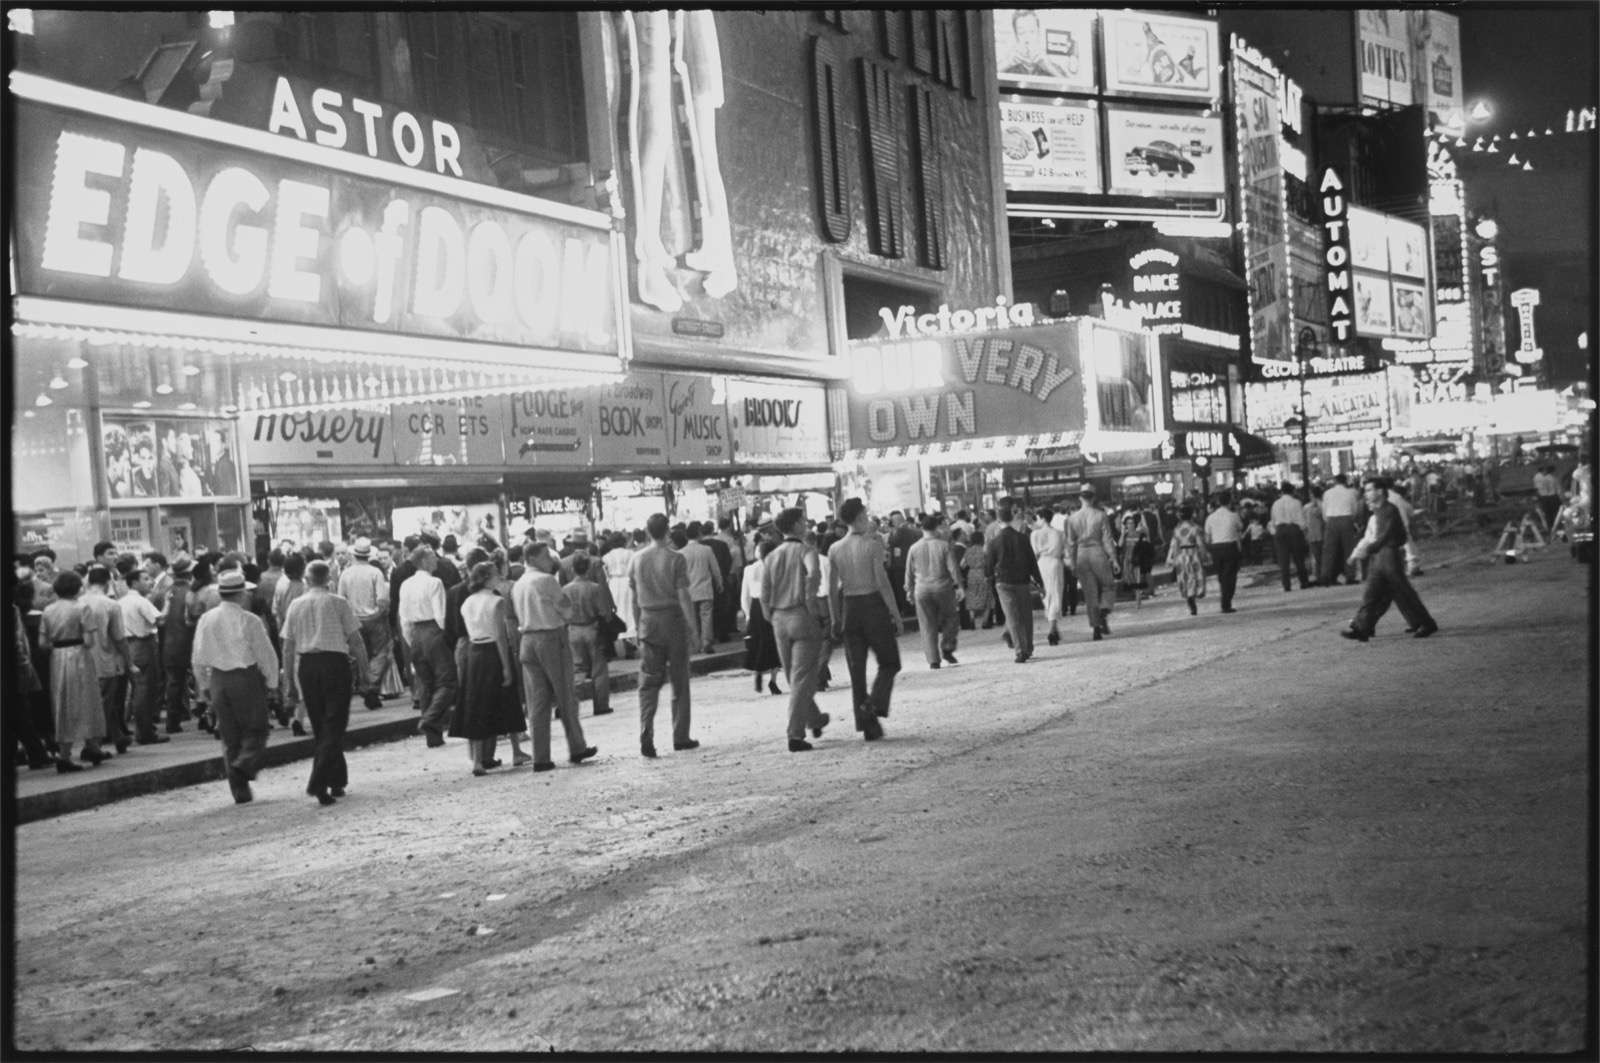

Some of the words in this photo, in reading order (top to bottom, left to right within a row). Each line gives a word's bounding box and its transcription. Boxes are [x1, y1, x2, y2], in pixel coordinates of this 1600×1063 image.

[269, 76, 463, 177] ASTOR
[1008, 109, 1045, 124] BUSINESS
[1066, 113, 1085, 126] HELP
[40, 130, 331, 304] EDGE
[338, 198, 409, 323] of
[412, 205, 611, 346] DOOM
[1320, 167, 1351, 341] AUTOMAT
[1133, 273, 1180, 292] DANCE
[879, 294, 1034, 340] Victoria
[851, 340, 944, 394] OUR
[954, 338, 1075, 402] VERY
[1310, 355, 1365, 373] THEATRE
[511, 389, 569, 437] FUDGE
[743, 396, 803, 428] BROOKS
[868, 390, 976, 442] OWN
[1332, 391, 1381, 415] ALCATRAZ
[599, 405, 645, 437] BOOK
[683, 414, 722, 440] MUSIC
[535, 497, 564, 513] FUDGE
[564, 496, 586, 512] SHOP
